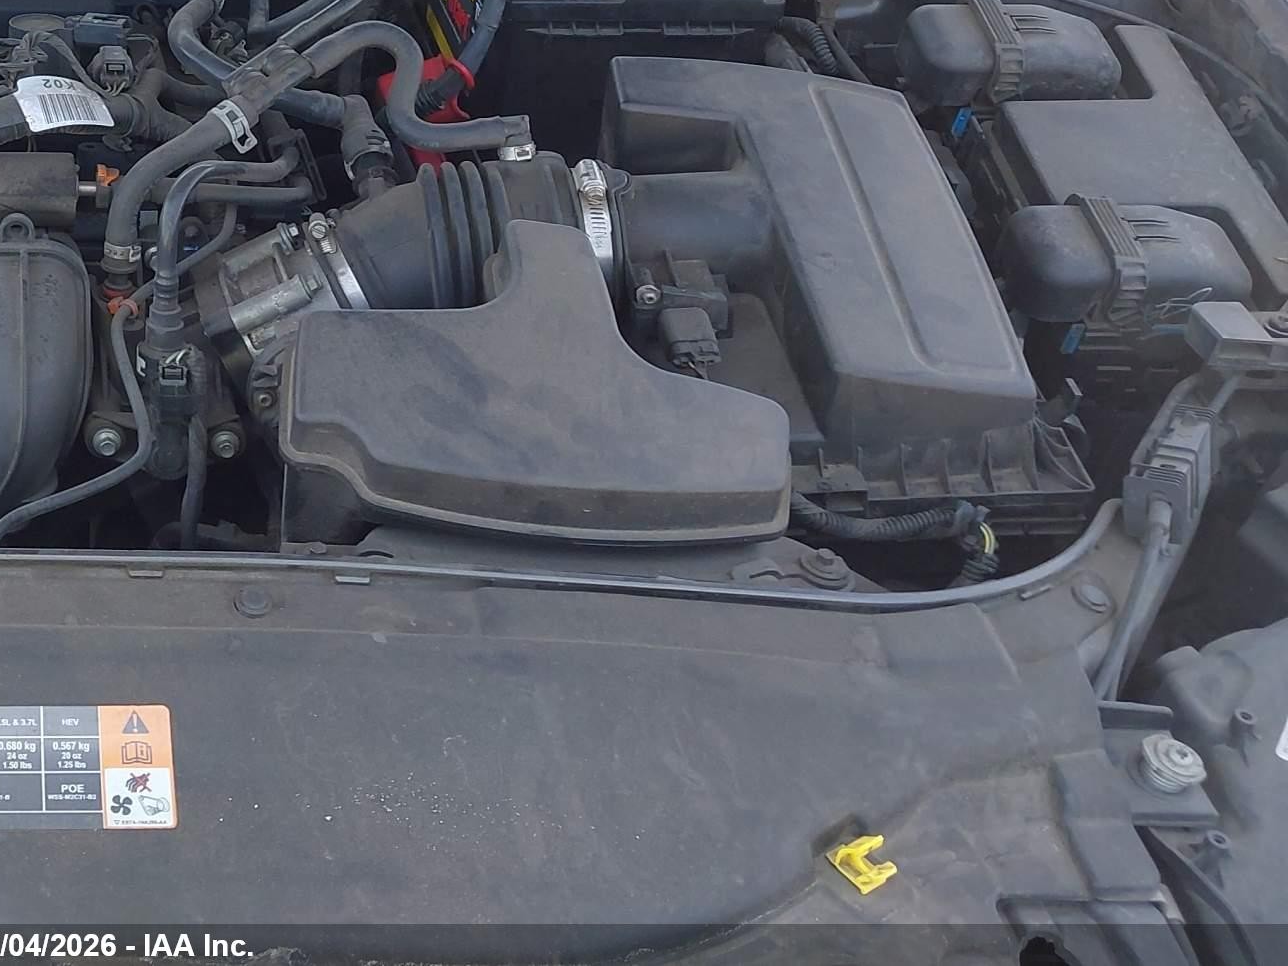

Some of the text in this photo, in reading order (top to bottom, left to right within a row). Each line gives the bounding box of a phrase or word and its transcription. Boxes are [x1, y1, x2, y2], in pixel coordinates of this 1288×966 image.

[42, 78, 76, 91] K02
[24, 741, 37, 752] kg
[52, 741, 90, 752] 0.567 kg
[7, 752, 17, 760] 24
[61, 752, 71, 760] 20
[2, 761, 32, 769] 1.50 lbs
[57, 761, 87, 769] 1.25 lbs
[61, 784, 85, 794] POE
